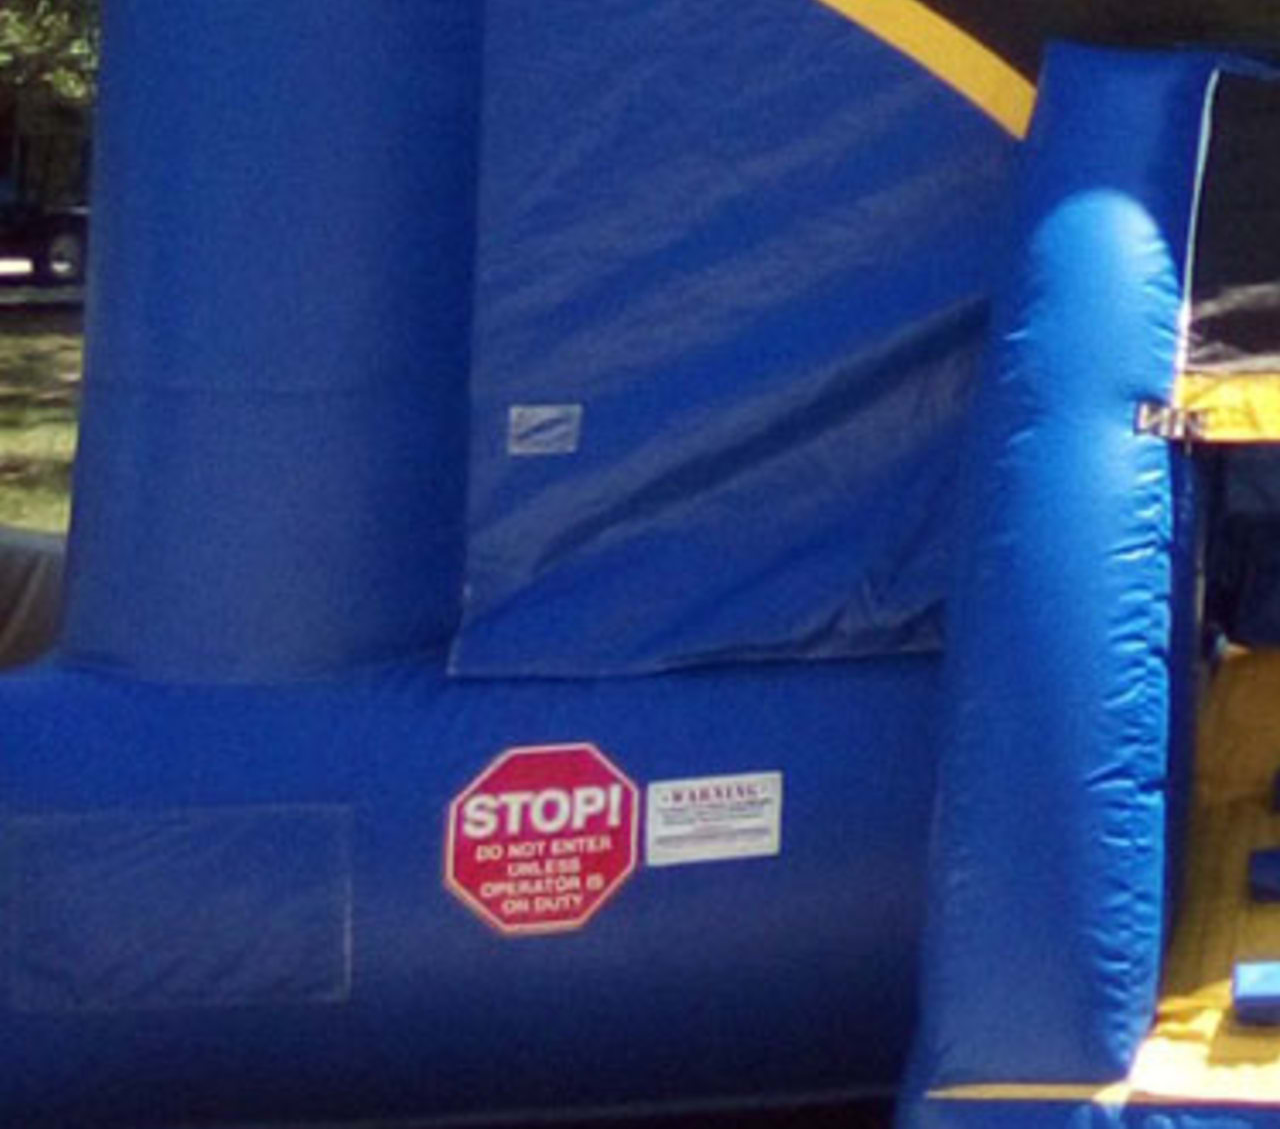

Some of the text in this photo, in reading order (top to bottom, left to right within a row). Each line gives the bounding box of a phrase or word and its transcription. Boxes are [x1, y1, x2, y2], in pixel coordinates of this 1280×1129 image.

[462, 783, 622, 838] STOP!
[475, 834, 612, 862] DO NOT ENTER
[507, 857, 580, 877] UNLESS
[480, 873, 604, 898] OPERATOR IS
[501, 894, 583, 915] ON DUTY
